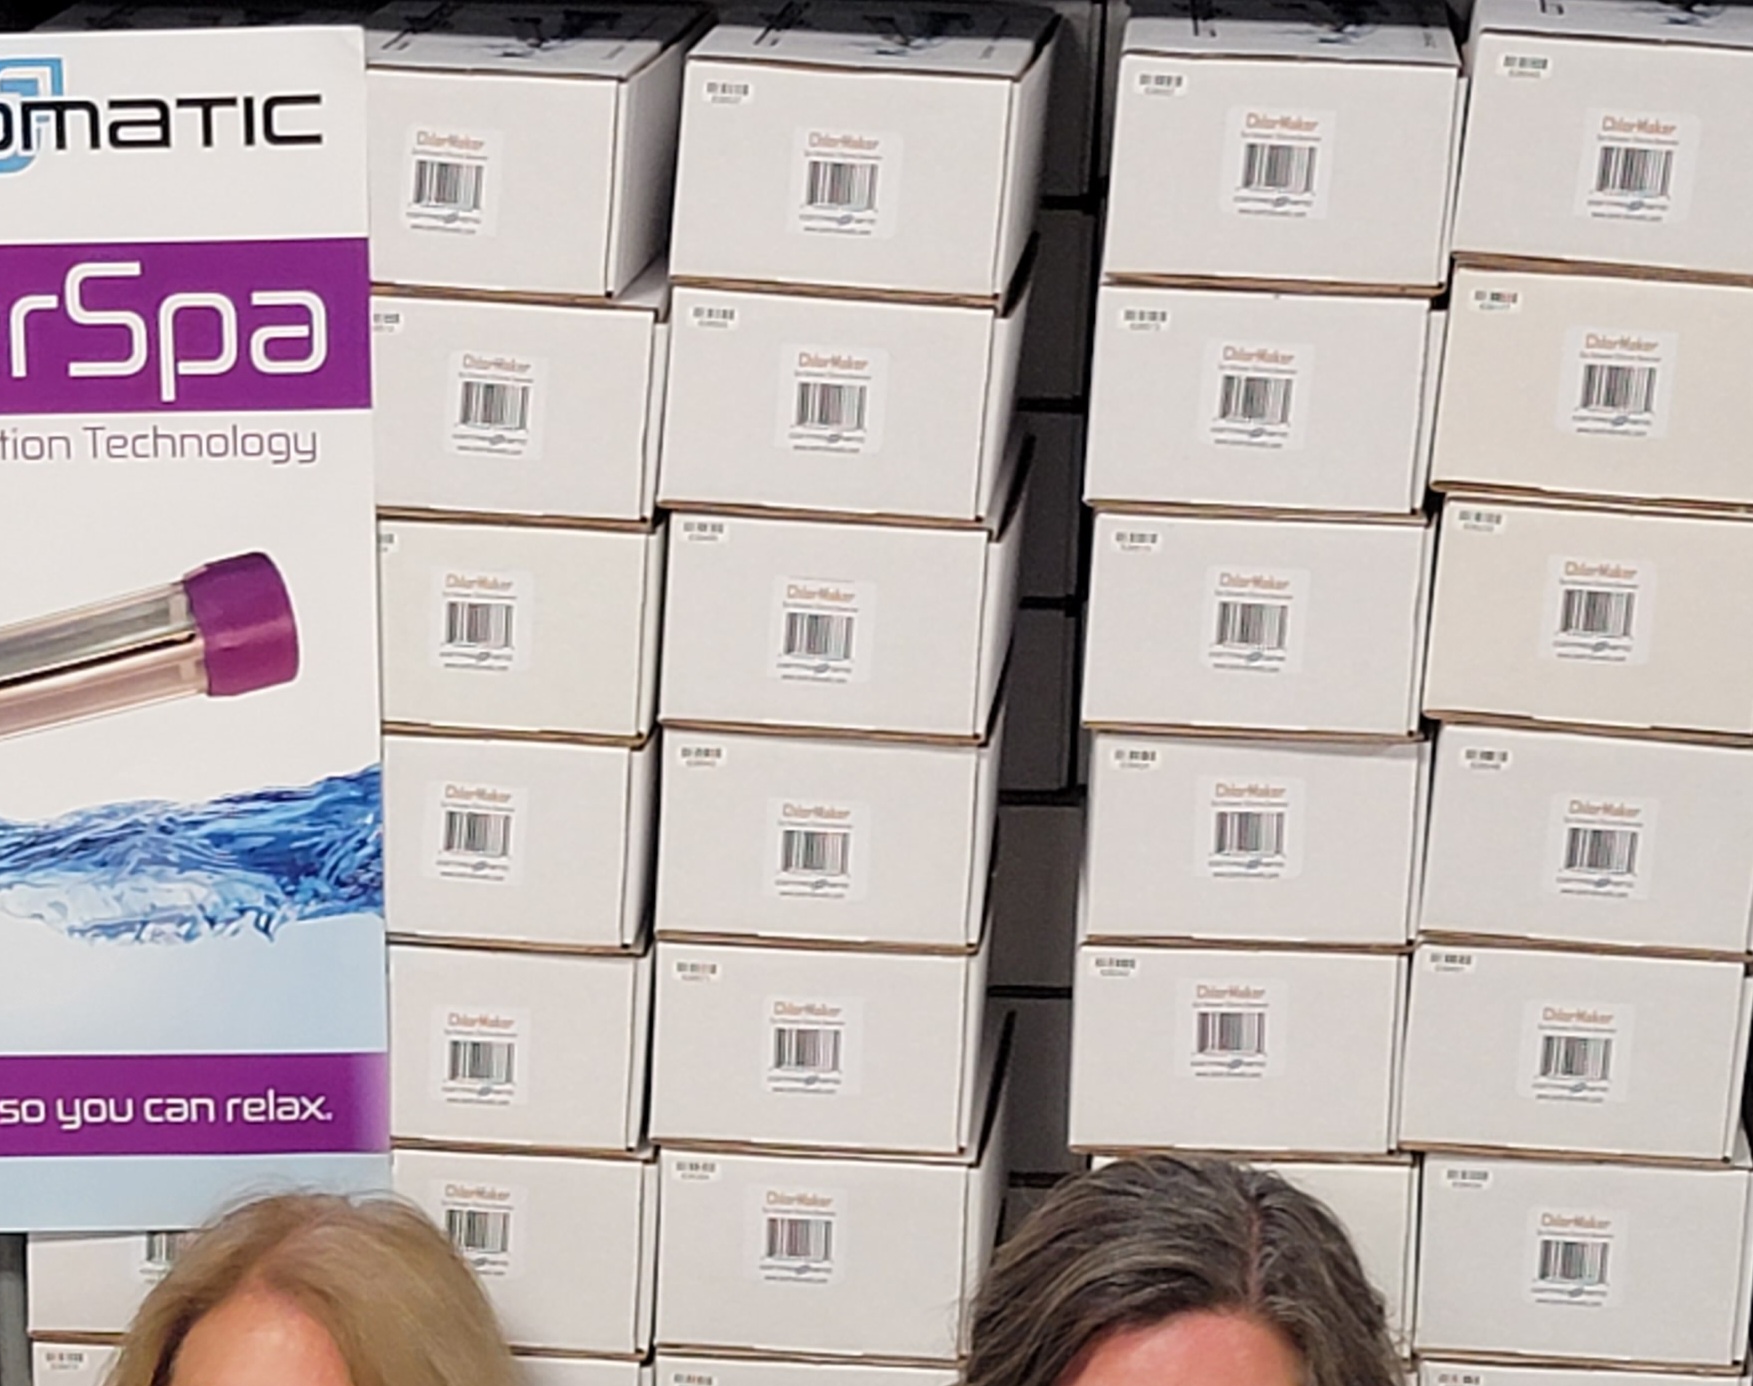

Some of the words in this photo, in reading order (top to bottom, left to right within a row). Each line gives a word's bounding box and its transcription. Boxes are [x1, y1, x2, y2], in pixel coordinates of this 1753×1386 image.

[82, 425, 318, 464] Technology
[56, 1098, 134, 1130] you
[144, 1098, 215, 1123] can
[226, 1089, 333, 1122] relax.
